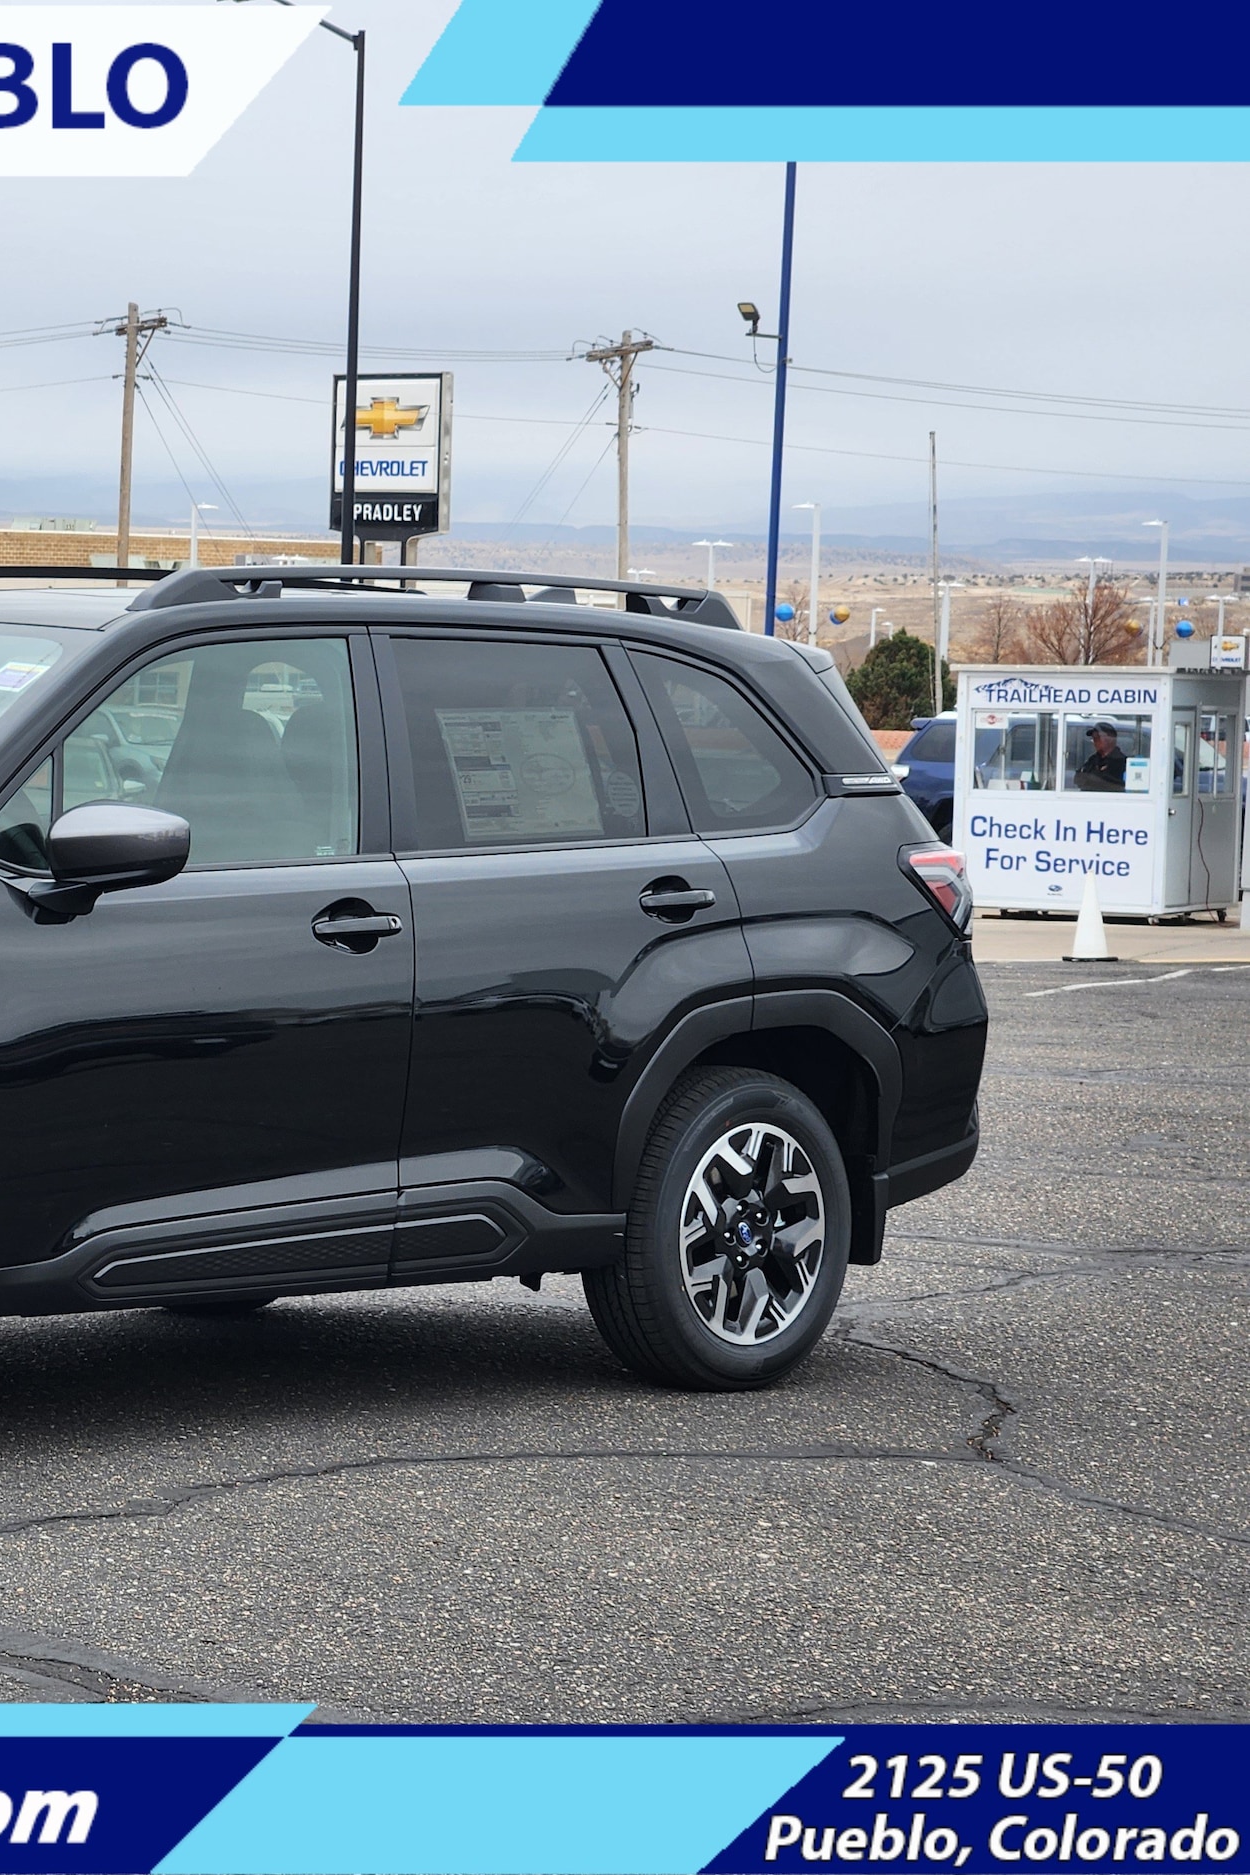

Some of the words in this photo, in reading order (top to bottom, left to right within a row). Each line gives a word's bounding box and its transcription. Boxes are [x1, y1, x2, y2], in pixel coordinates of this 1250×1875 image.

[352, 503, 423, 522] PRADLEY
[985, 687, 1091, 704] TRAILHEAD
[1097, 688, 1157, 704] CABIN
[970, 815, 1046, 841] Check
[1055, 819, 1077, 842] In
[1086, 820, 1148, 846] Here
[985, 847, 1027, 871] For
[1034, 850, 1130, 877] Service
